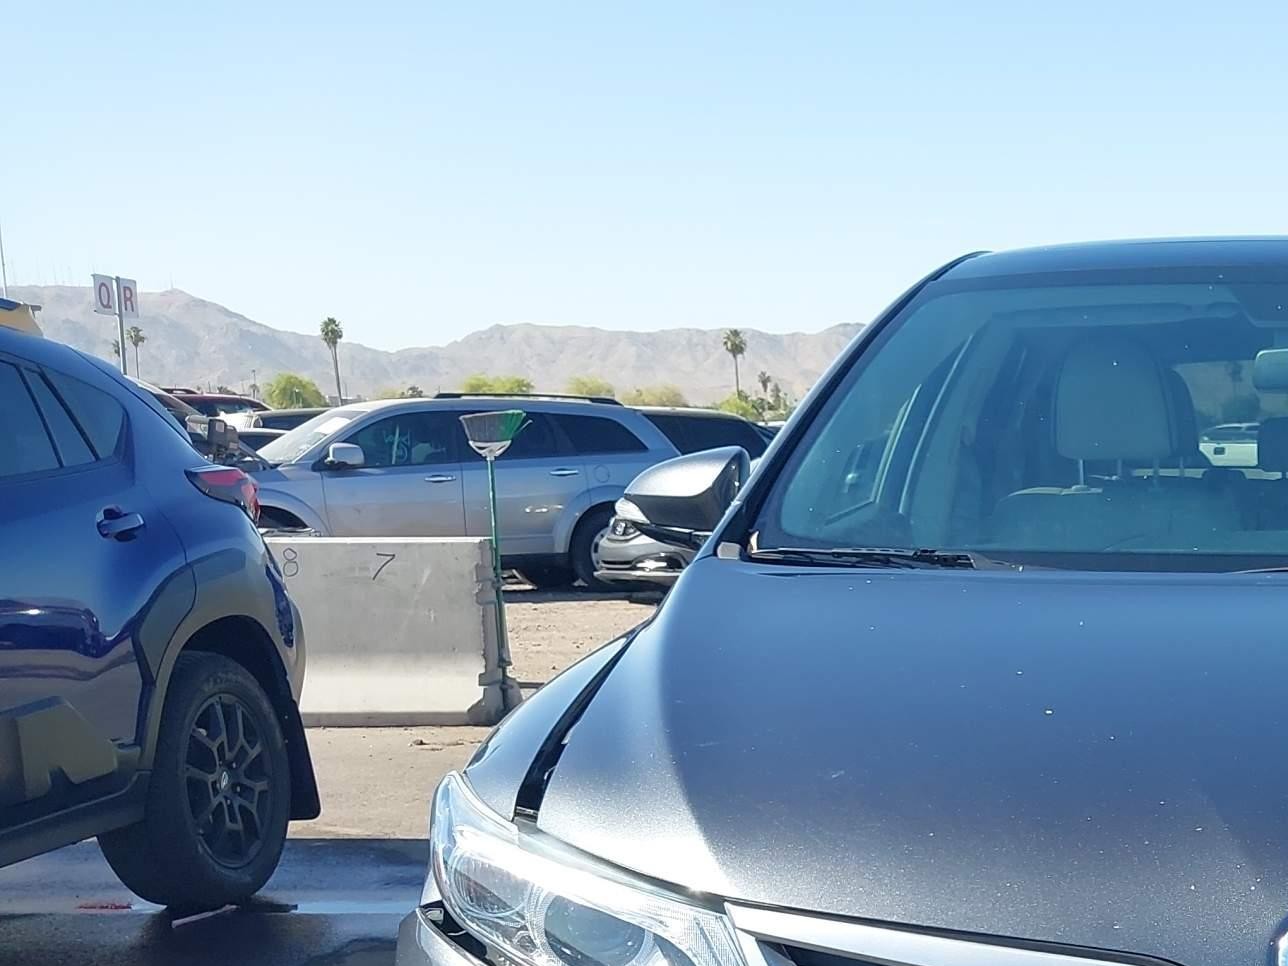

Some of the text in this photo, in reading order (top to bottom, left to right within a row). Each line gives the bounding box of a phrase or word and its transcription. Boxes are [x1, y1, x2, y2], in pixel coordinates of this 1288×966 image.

[98, 282, 112, 309] Q
[122, 286, 135, 312] R
[283, 548, 299, 577] 8
[372, 552, 396, 580] 7
